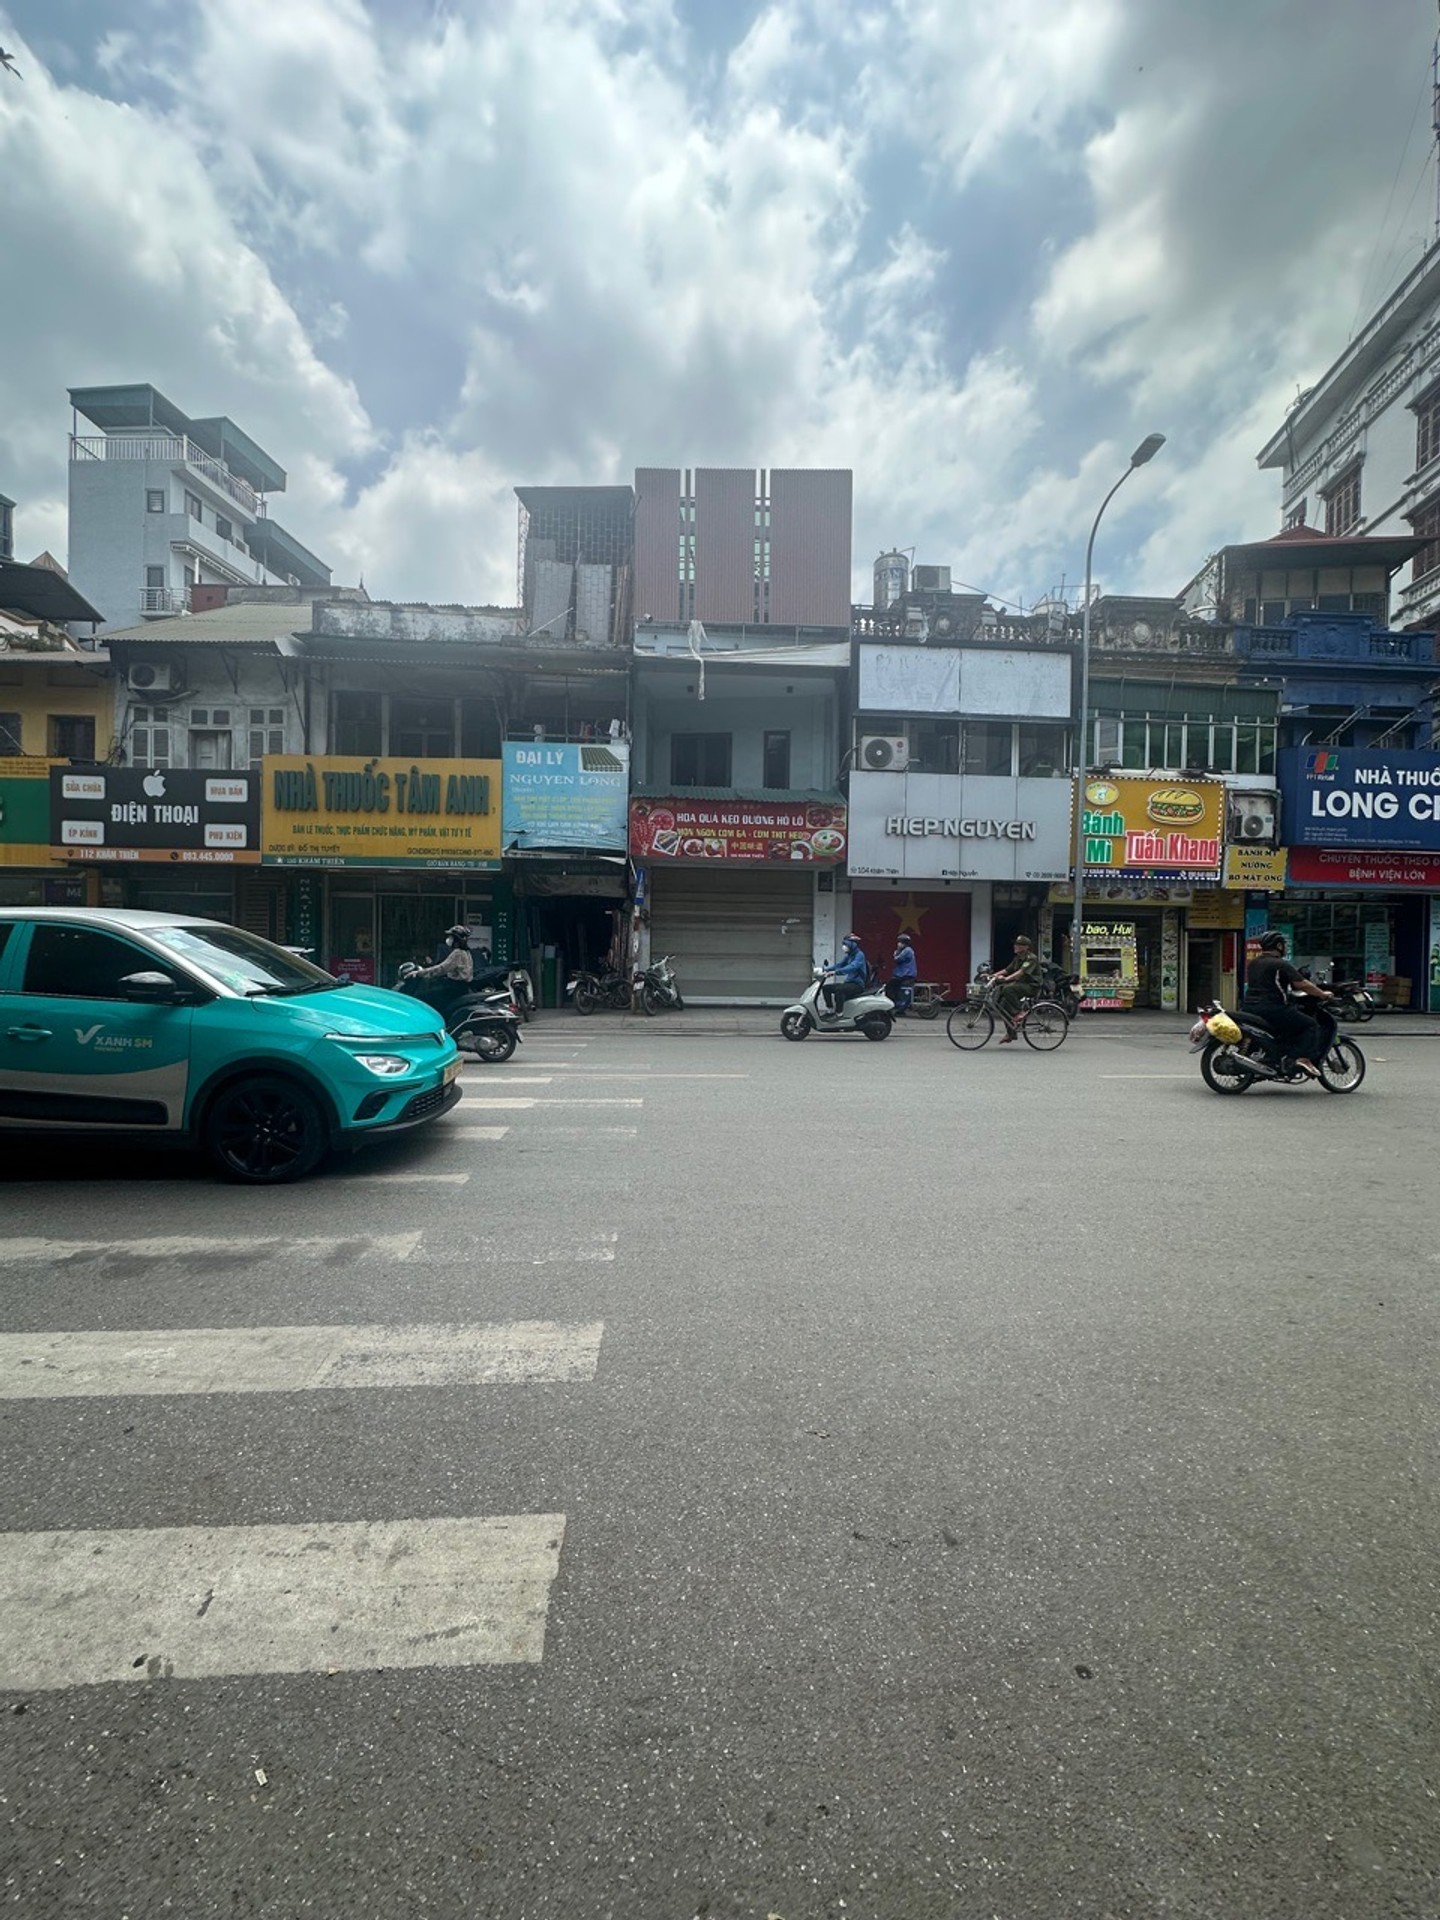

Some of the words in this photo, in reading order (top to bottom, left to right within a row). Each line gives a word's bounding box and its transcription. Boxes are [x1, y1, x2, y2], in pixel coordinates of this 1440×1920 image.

[516, 751, 541, 767] ĐẠI
[547, 749, 564, 765] LÝ
[579, 777, 620, 787] LONG
[1306, 773, 1317, 781] FPT
[1317, 773, 1335, 781] Retail
[1355, 765, 1392, 785] NHÀ
[275, 762, 318, 811] NHÀ
[323, 759, 389, 813] THUỐC
[395, 765, 440, 814] TÂM
[446, 774, 489, 815] ANH
[111, 800, 147, 826] ĐIỆN
[153, 805, 199, 826] THOẠI
[1311, 789, 1399, 819] LONG
[676, 813, 696, 823] HOA
[886, 816, 939, 837] HIEP
[943, 818, 1037, 841] NGUYEN
[80, 849, 94, 858] 112
[1086, 837, 1112, 864] Mì
[1126, 828, 1166, 861] Tuấn
[1167, 833, 1219, 865] Khang
[1404, 856, 1430, 865] THEO
[1349, 867, 1375, 880] BỆNH
[1379, 869, 1402, 881] VIỆN
[95, 1036, 133, 1047] XANH
[133, 1038, 153, 1048] SM
